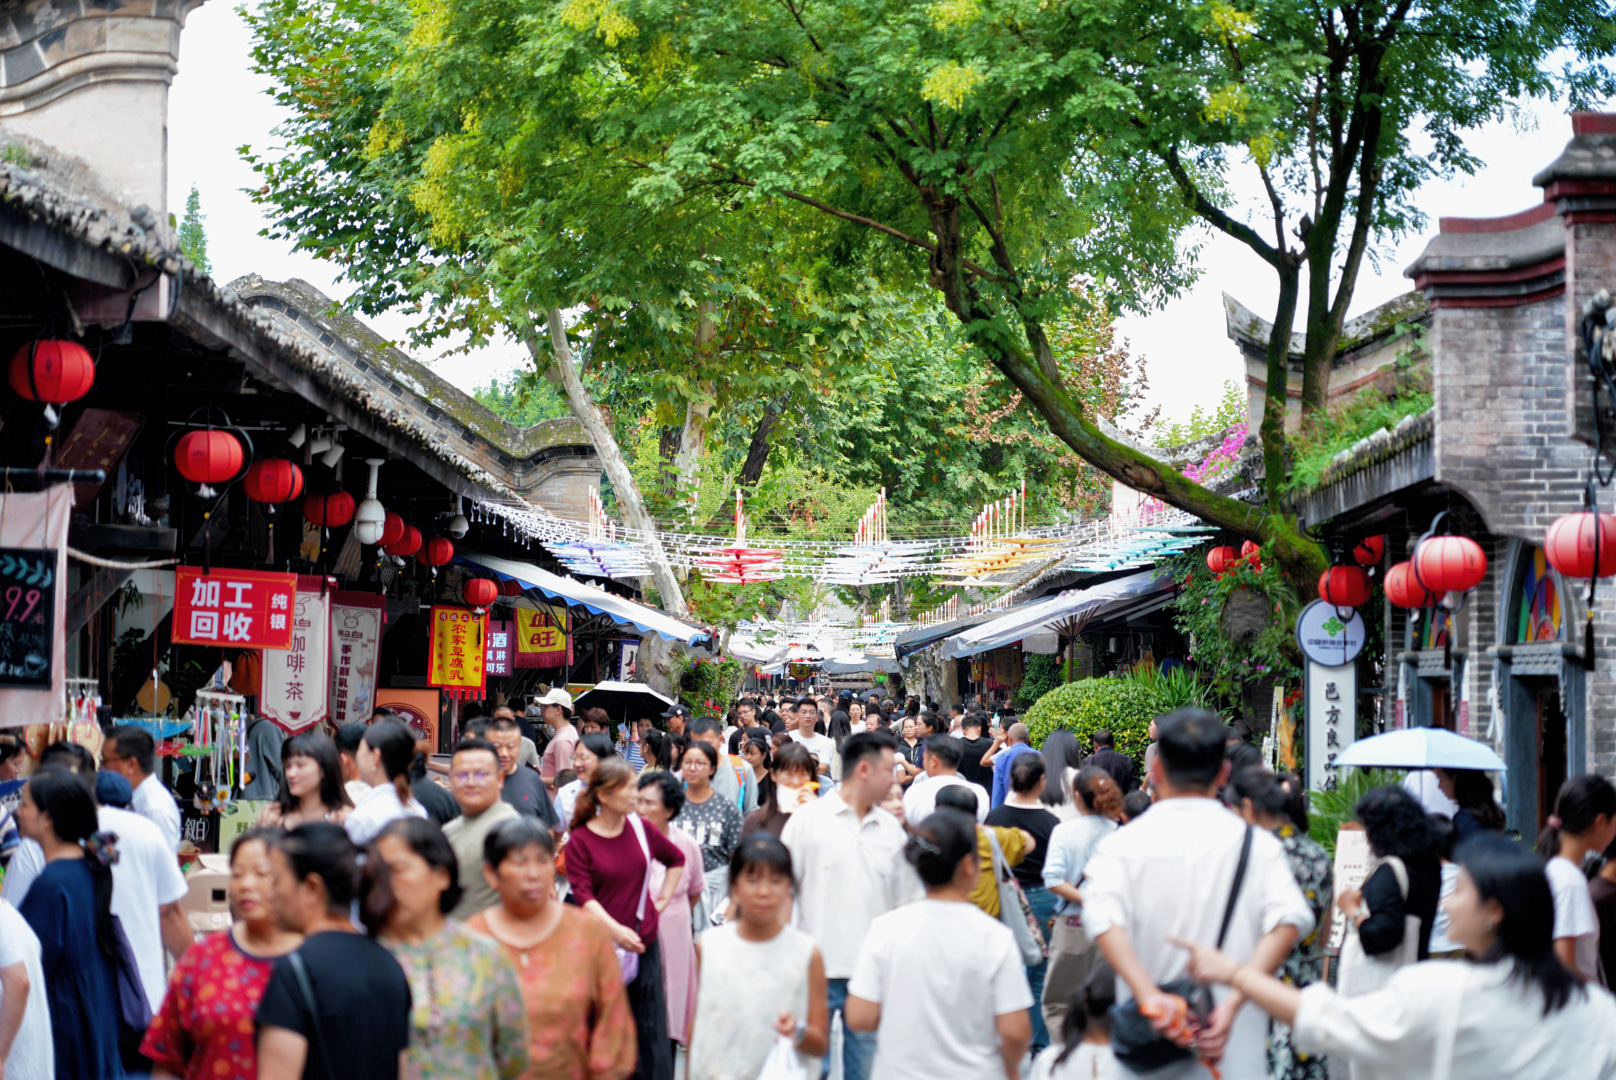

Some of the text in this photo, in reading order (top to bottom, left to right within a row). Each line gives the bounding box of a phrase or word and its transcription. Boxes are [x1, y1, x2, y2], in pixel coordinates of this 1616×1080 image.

[190, 578, 253, 608] 加工
[190, 611, 253, 642] 回收
[270, 593, 289, 630] 纯银
[449, 624, 467, 680] 农家豆腐乳
